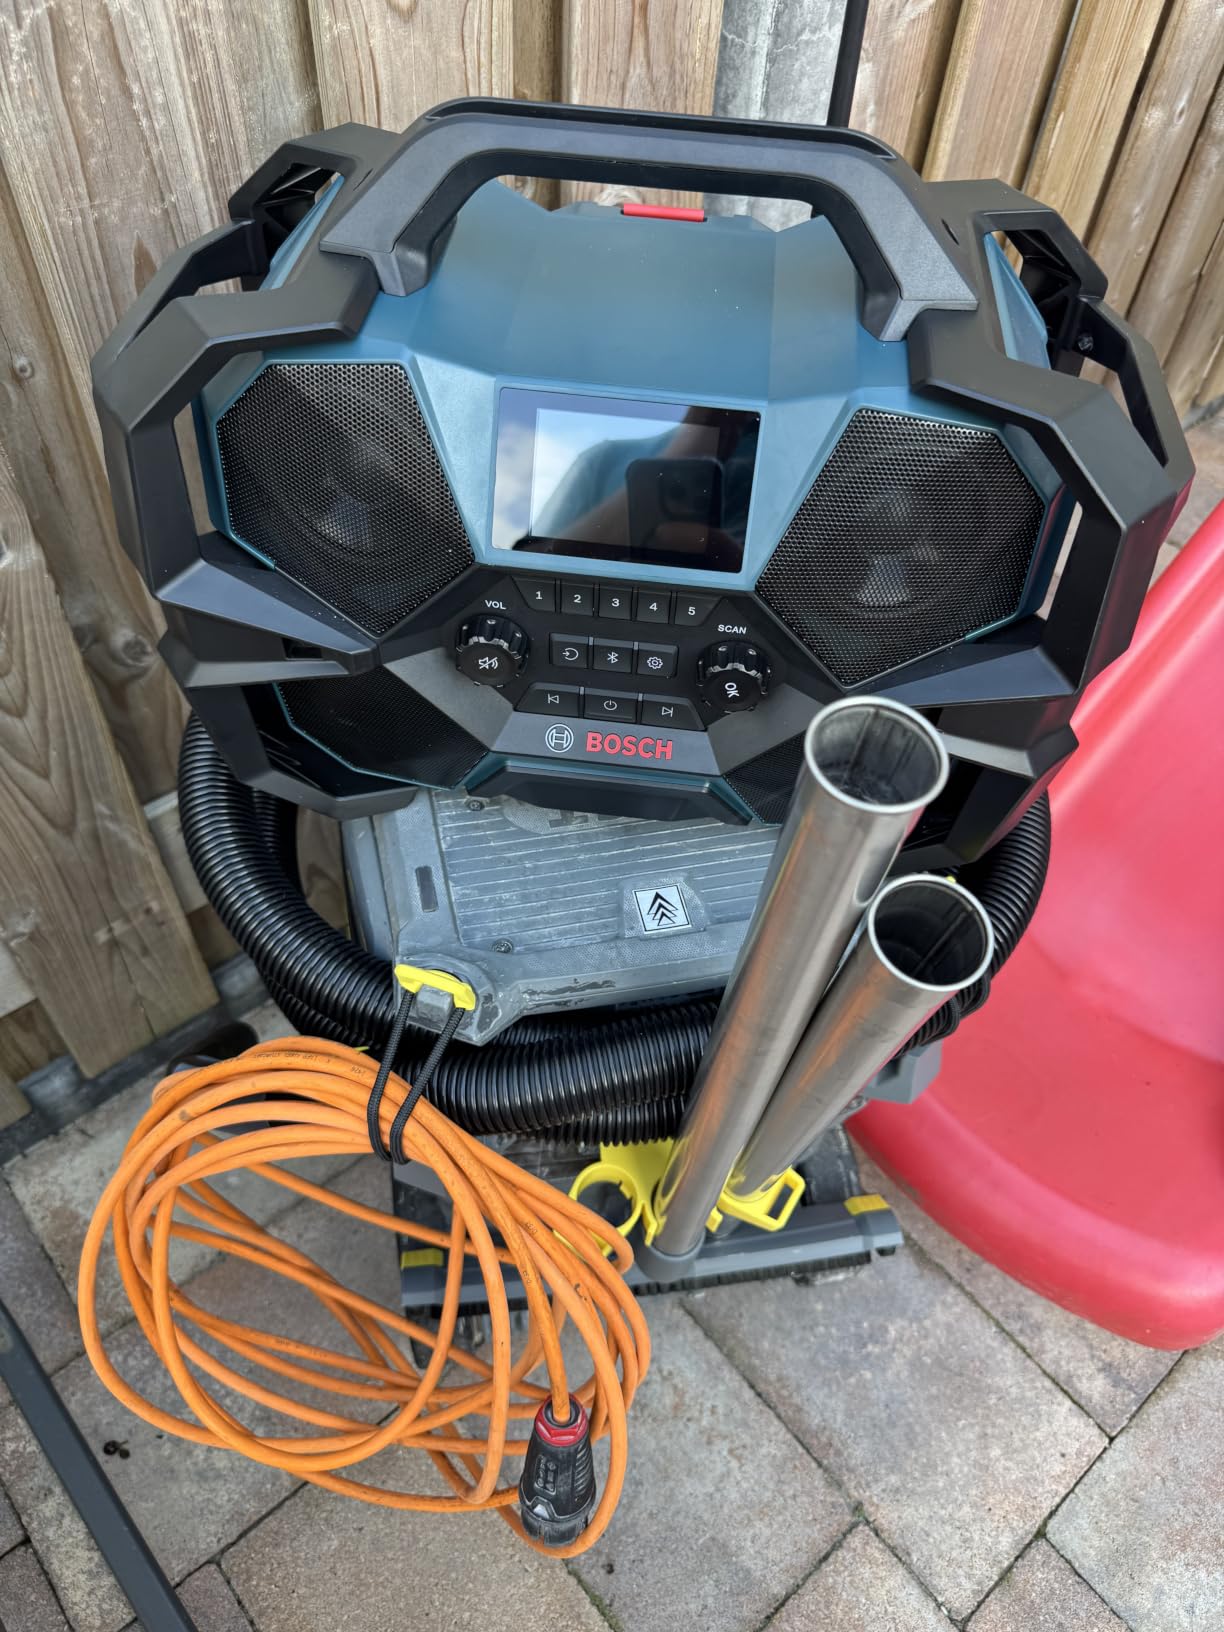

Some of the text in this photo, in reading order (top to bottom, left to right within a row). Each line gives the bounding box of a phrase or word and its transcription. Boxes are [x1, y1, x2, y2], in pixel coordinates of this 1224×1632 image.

[484, 599, 507, 610] VOL
[535, 590, 696, 616] 1 2 3 4 5
[717, 624, 747, 635] SCAN
[724, 682, 740, 698] OK
[585, 731, 673, 760] BOSCH
